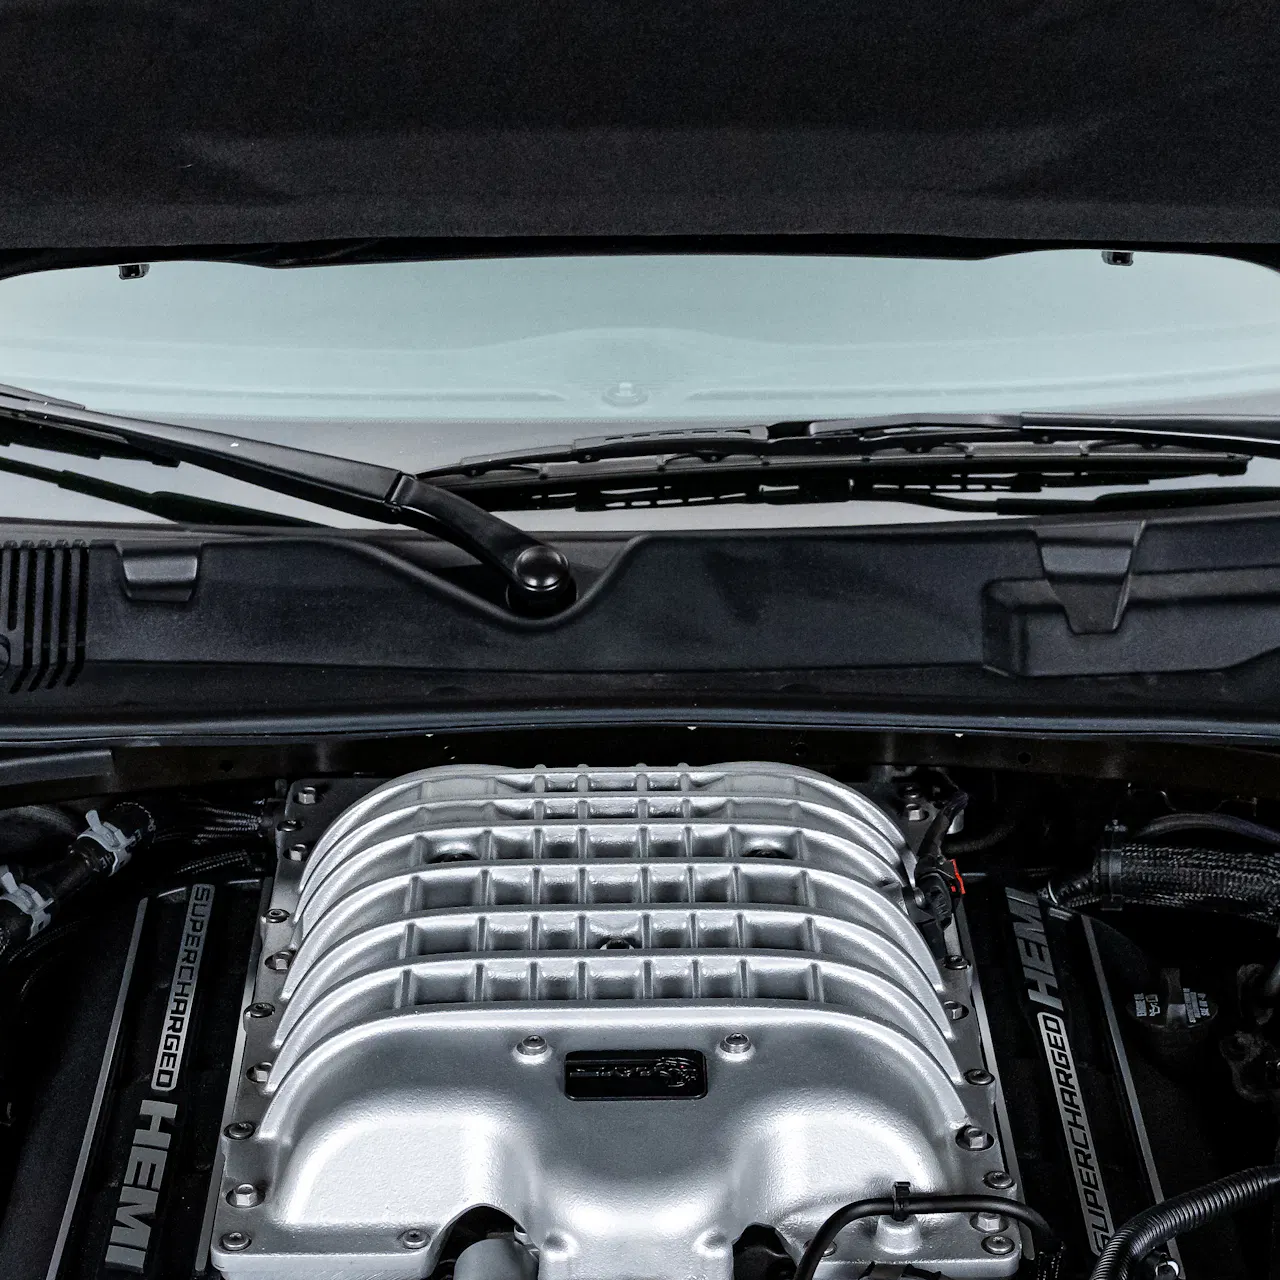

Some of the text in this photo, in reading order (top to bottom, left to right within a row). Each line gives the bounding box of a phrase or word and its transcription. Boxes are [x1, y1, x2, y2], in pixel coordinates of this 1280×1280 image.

[105, 884, 214, 1273] SUPERCHARGED HEMI
[1005, 886, 1113, 1254] SUPERCHARGED HEMI
